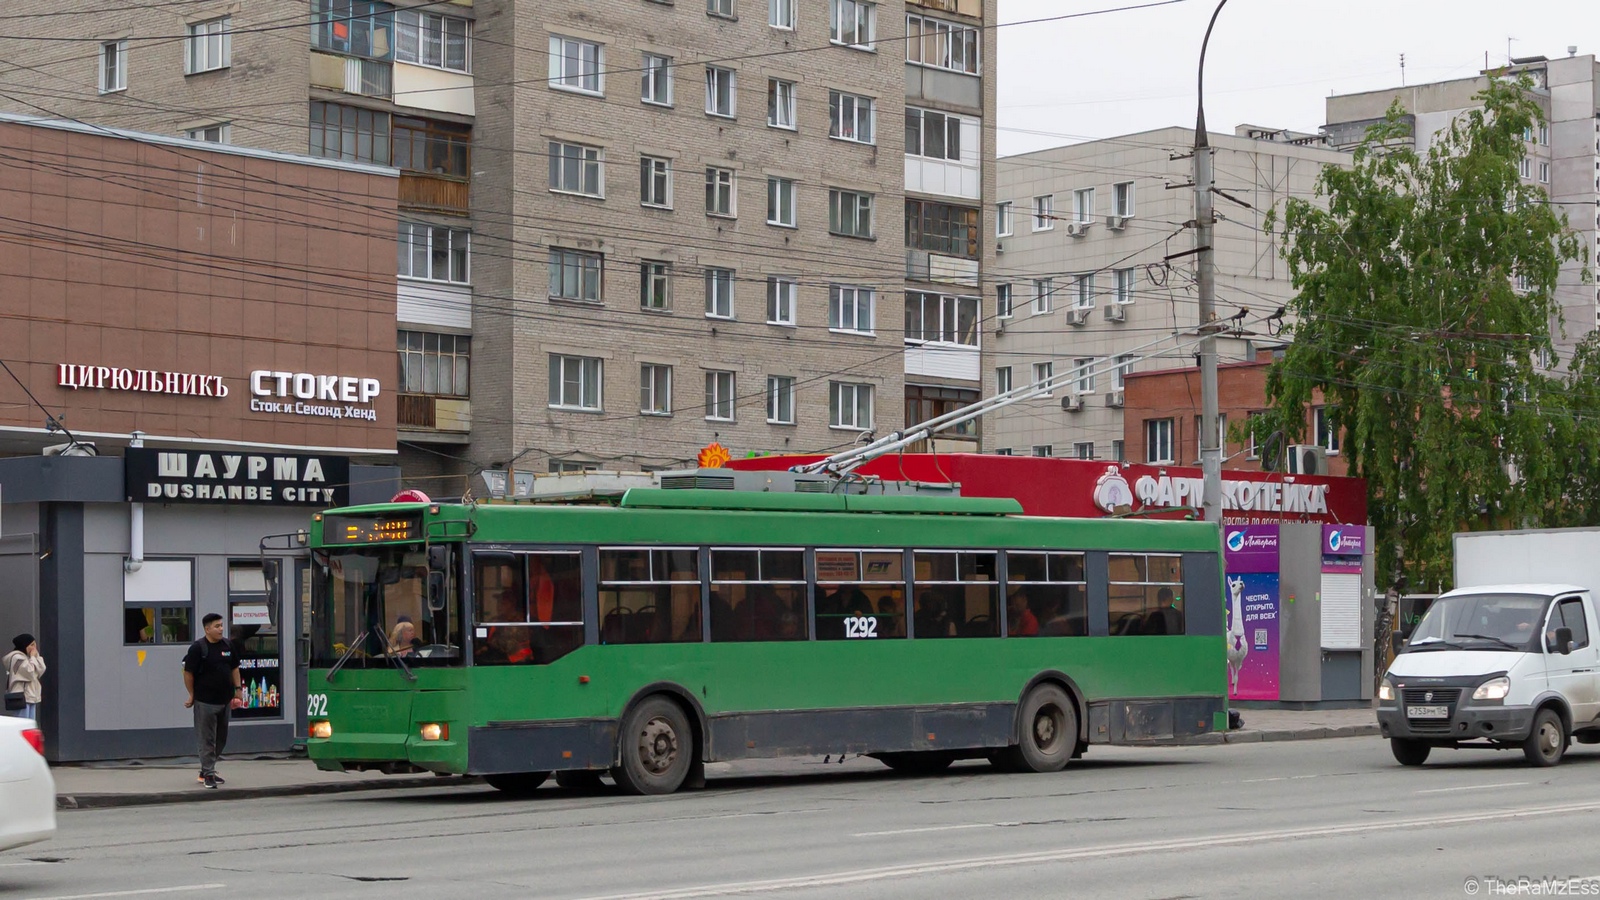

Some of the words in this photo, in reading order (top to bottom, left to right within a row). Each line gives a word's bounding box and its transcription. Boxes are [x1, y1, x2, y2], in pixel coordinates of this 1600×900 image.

[57, 363, 228, 398] ЦИРЮЛЬНИКЪ
[250, 370, 380, 403] СТОКЕР
[250, 399, 281, 413] Сток
[284, 403, 292, 413] и
[295, 402, 341, 418] Секонд
[344, 406, 376, 421] Хенд
[158, 452, 325, 482] ШАУРМА
[147, 483, 272, 501] DUSHANBE
[282, 487, 335, 502] CITY
[1135, 475, 1328, 514] ФАРМКОПЕЙКА
[843, 616, 877, 638] 1292
[1245, 613, 1258, 621] ДЛЯ
[1404, 611, 1420, 625] Va
[238, 659, 256, 669] ОДНЫЕ
[257, 658, 279, 668] НАПИТКИ
[307, 693, 328, 716] 292
